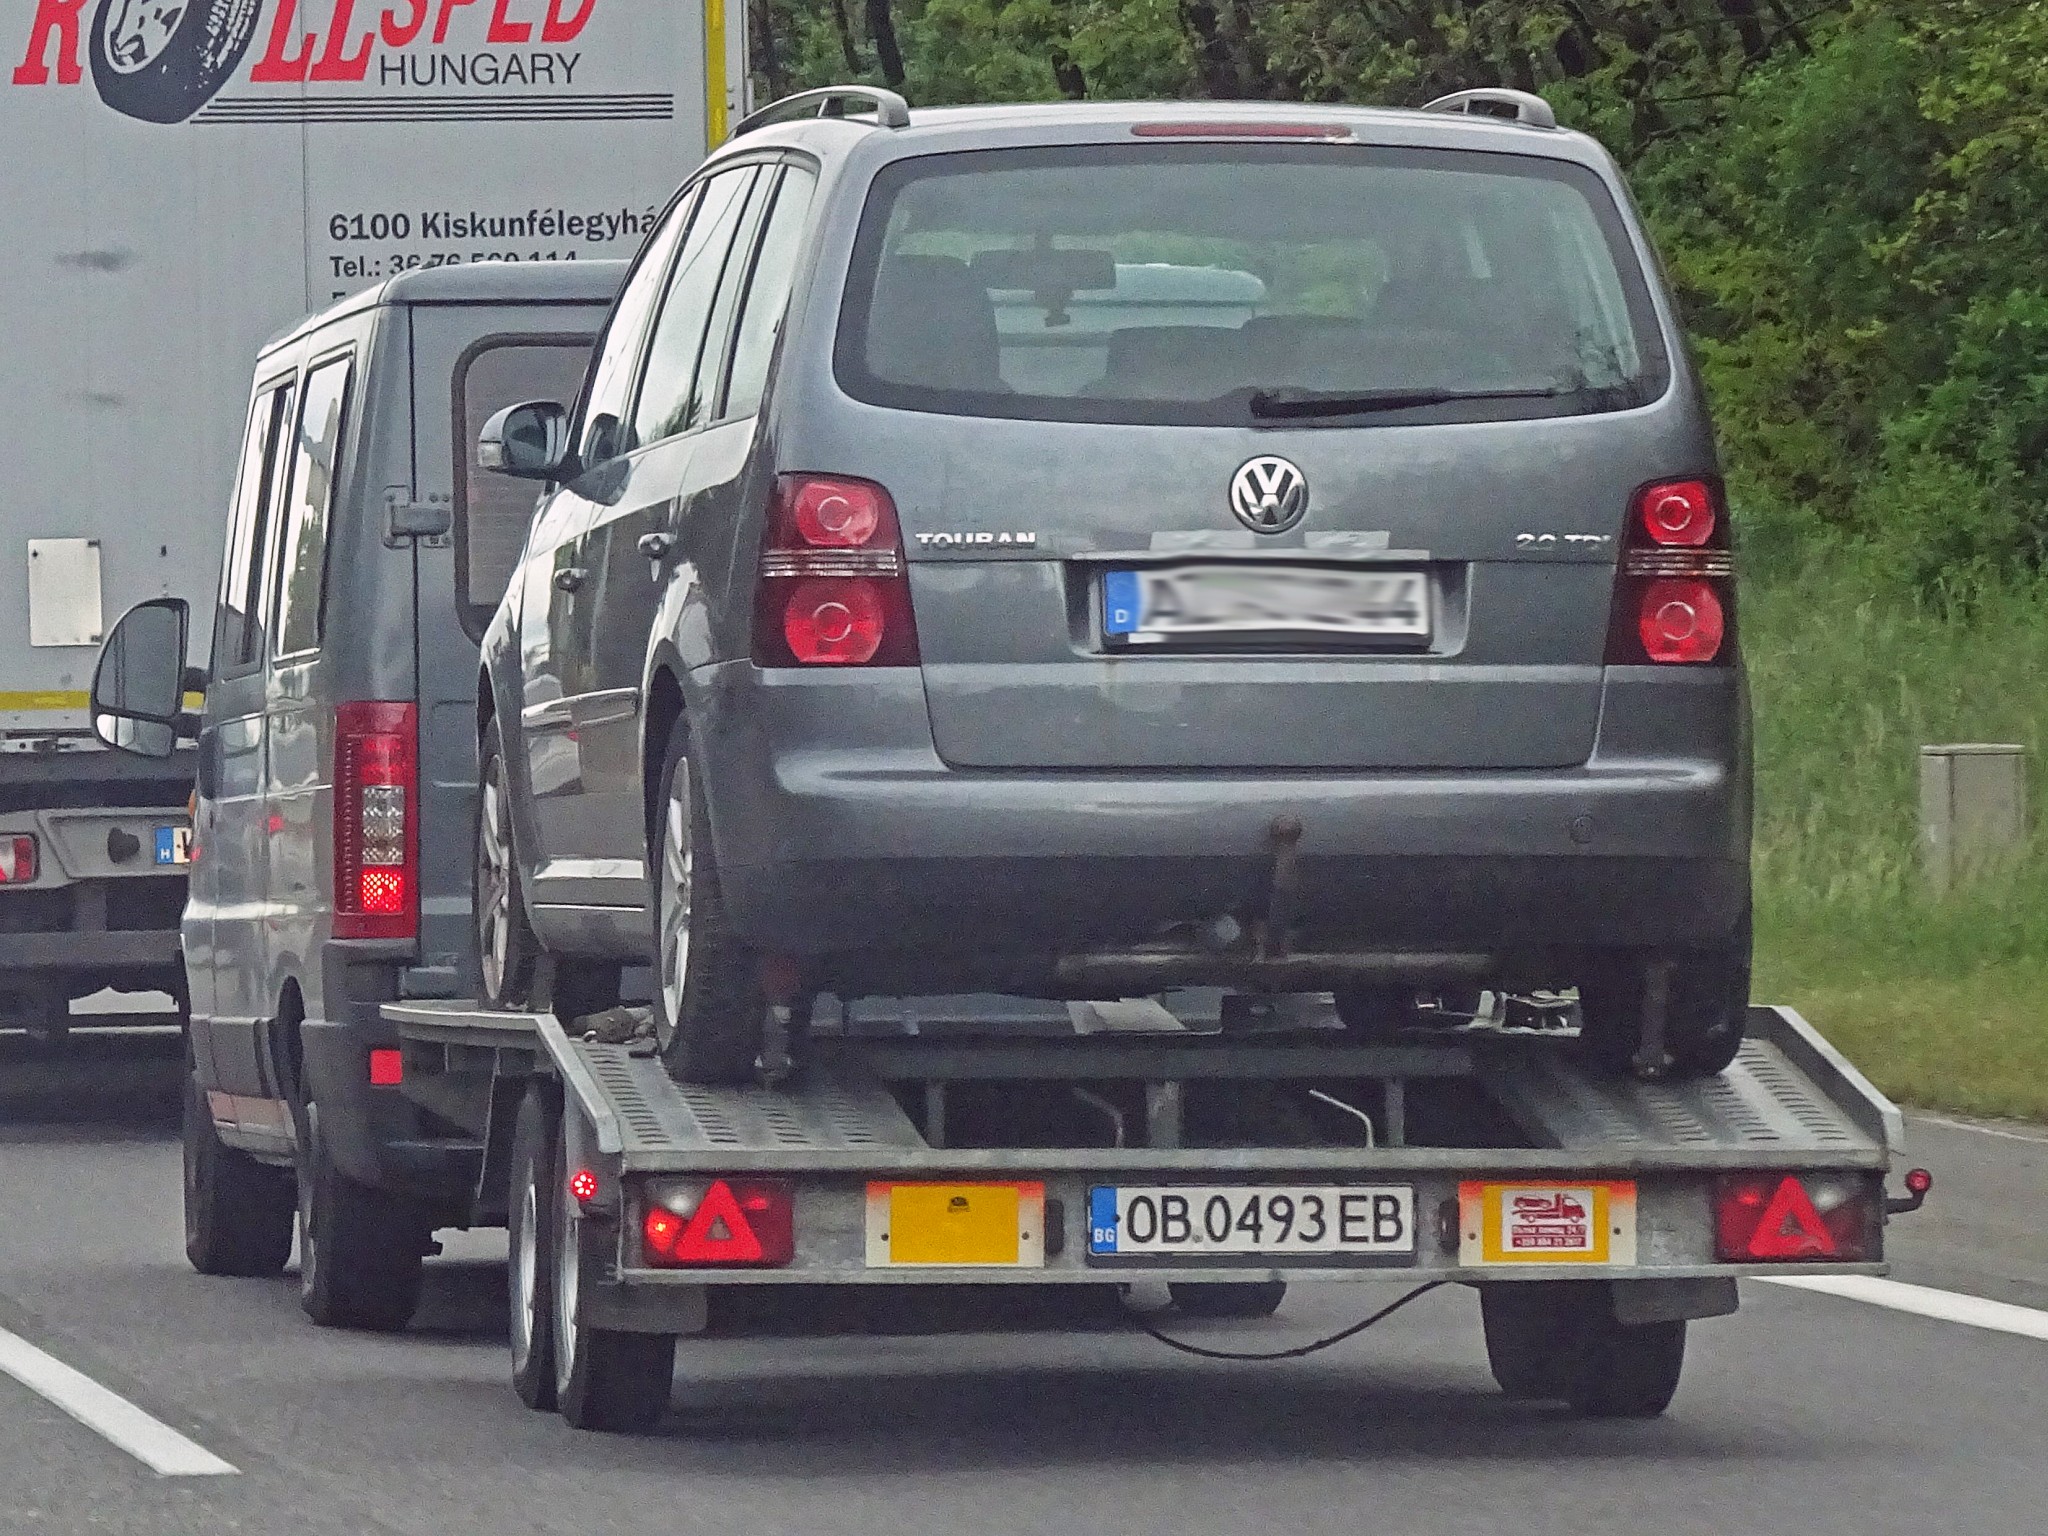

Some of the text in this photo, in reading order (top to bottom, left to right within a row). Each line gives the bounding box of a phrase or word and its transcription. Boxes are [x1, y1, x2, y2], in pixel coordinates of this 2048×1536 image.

[380, 53, 581, 86] HUNGARY
[329, 213, 411, 241] 6100
[329, 255, 381, 277] Tel.:
[915, 532, 1036, 548] TOURAN
[1115, 609, 1128, 624] D
[160, 848, 171, 860] H
[1126, 1194, 1404, 1243] OB 0493 EB
[1093, 1228, 1115, 1243] BG
